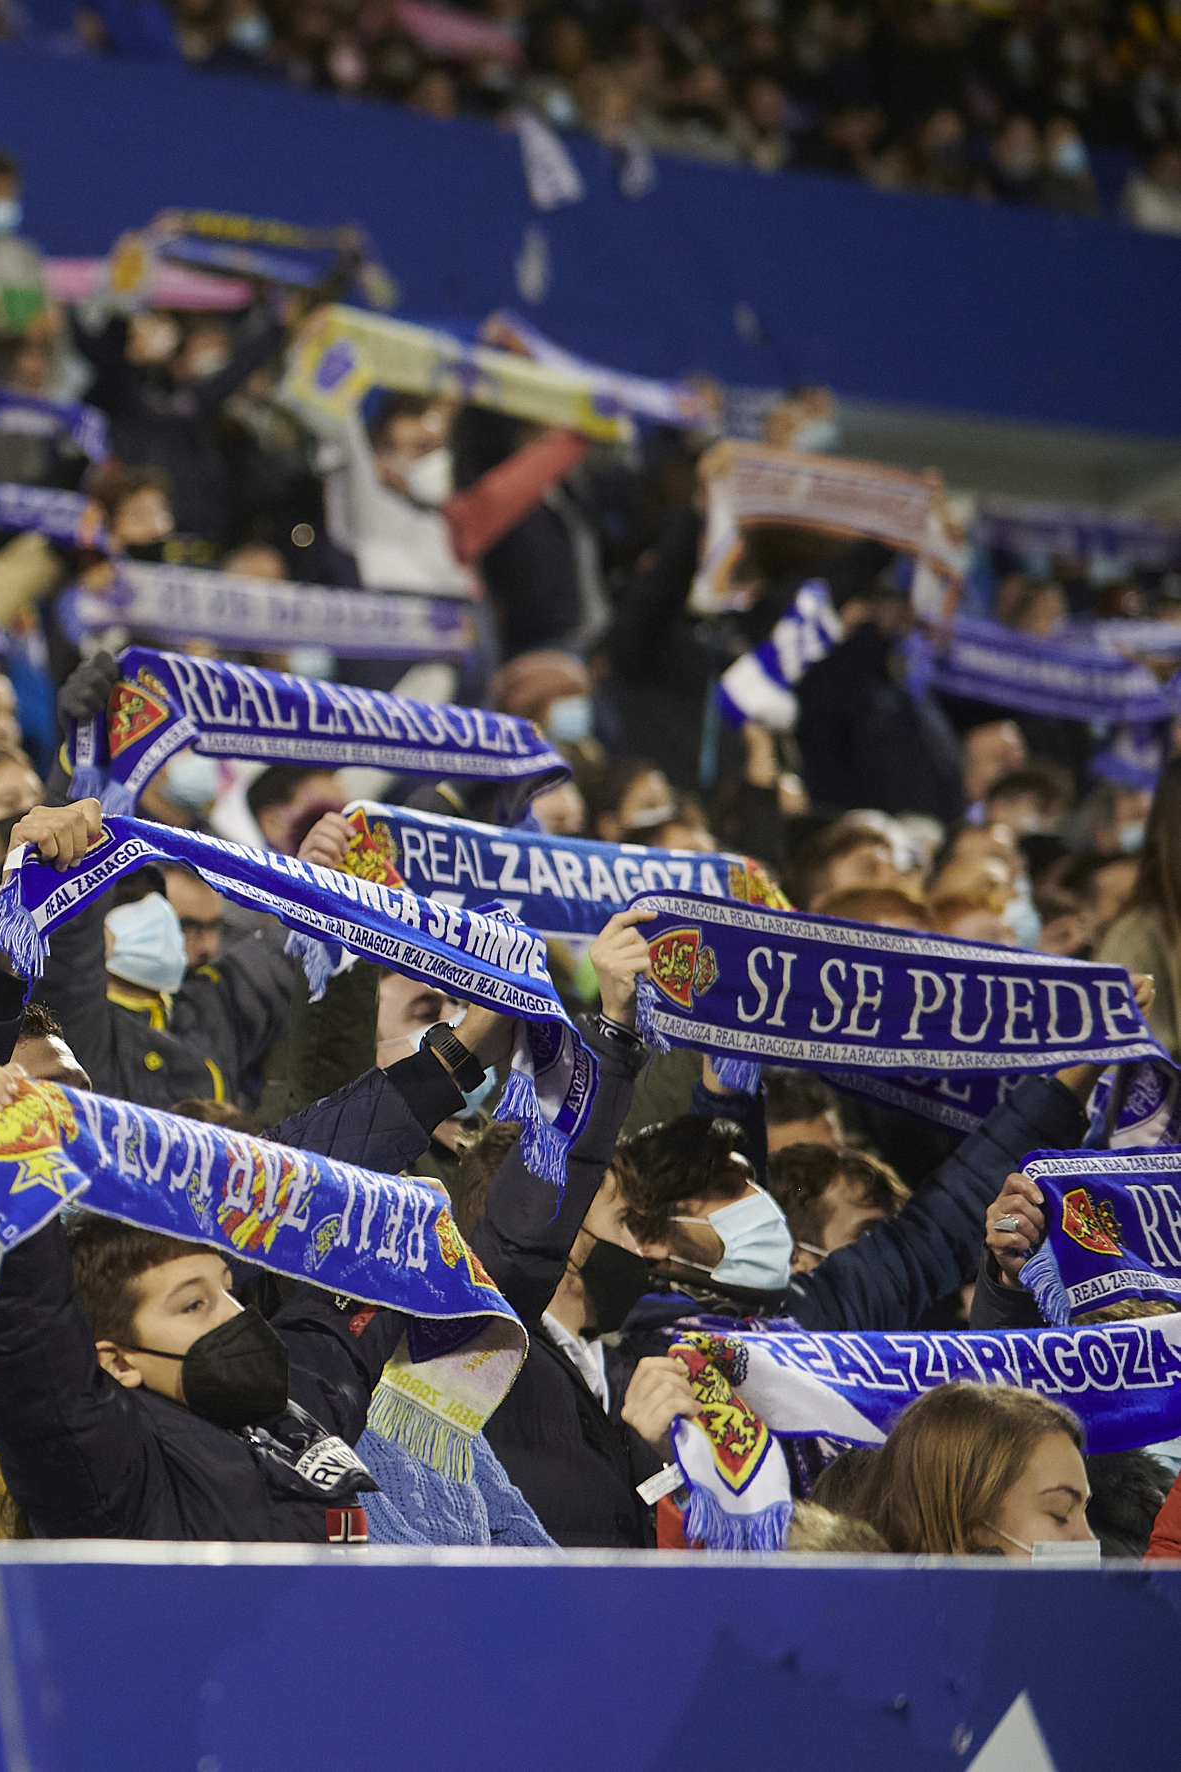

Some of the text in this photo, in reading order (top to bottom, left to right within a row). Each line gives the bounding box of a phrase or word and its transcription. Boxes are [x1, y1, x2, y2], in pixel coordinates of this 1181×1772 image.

[159, 651, 530, 755] REAL ZARAGOZA
[45, 887, 77, 921] REAL
[72, 838, 154, 895] ZARAGOZ
[401, 827, 497, 891] REAL
[492, 842, 724, 905] ZARAGOZA
[272, 893, 322, 926] ZARAGOZA
[323, 914, 347, 939] REAL
[348, 925, 401, 959] ZARAGOZA
[401, 946, 426, 970] REAL
[424, 955, 476, 991] ZARAGOZA
[474, 977, 499, 998] REAL
[499, 985, 563, 1014] ZARAGOZA
[308, 863, 420, 929] NUNCA
[425, 897, 463, 948] SE
[464, 910, 550, 983] RINDE
[665, 899, 727, 924] ZARAGOZA
[730, 910, 759, 927] REAL
[758, 915, 822, 940] ZARAGOZA
[824, 927, 851, 944] REAL
[849, 931, 917, 952] ZARAGOZA
[736, 945, 1150, 1044] SI SE PUEDE
[656, 1015, 712, 1041] ZARAGOZA
[715, 1029, 744, 1046] REAL
[743, 1035, 805, 1058] ZARAGOZA
[808, 1042, 836, 1060] REAL
[835, 1046, 910, 1065] ZARAGOZA
[72, 1088, 435, 1273] REAL ZARAGOZA
[1025, 1160, 1046, 1179] AL
[1045, 1159, 1101, 1175] ZARAGOZA
[1100, 1157, 1127, 1173] REAL
[1124, 1184, 1181, 1268] RE
[1072, 1277, 1111, 1305] REAL
[1109, 1272, 1163, 1291] ZARAGOZA
[749, 1326, 1181, 1394] REAL ZARAGOZA
